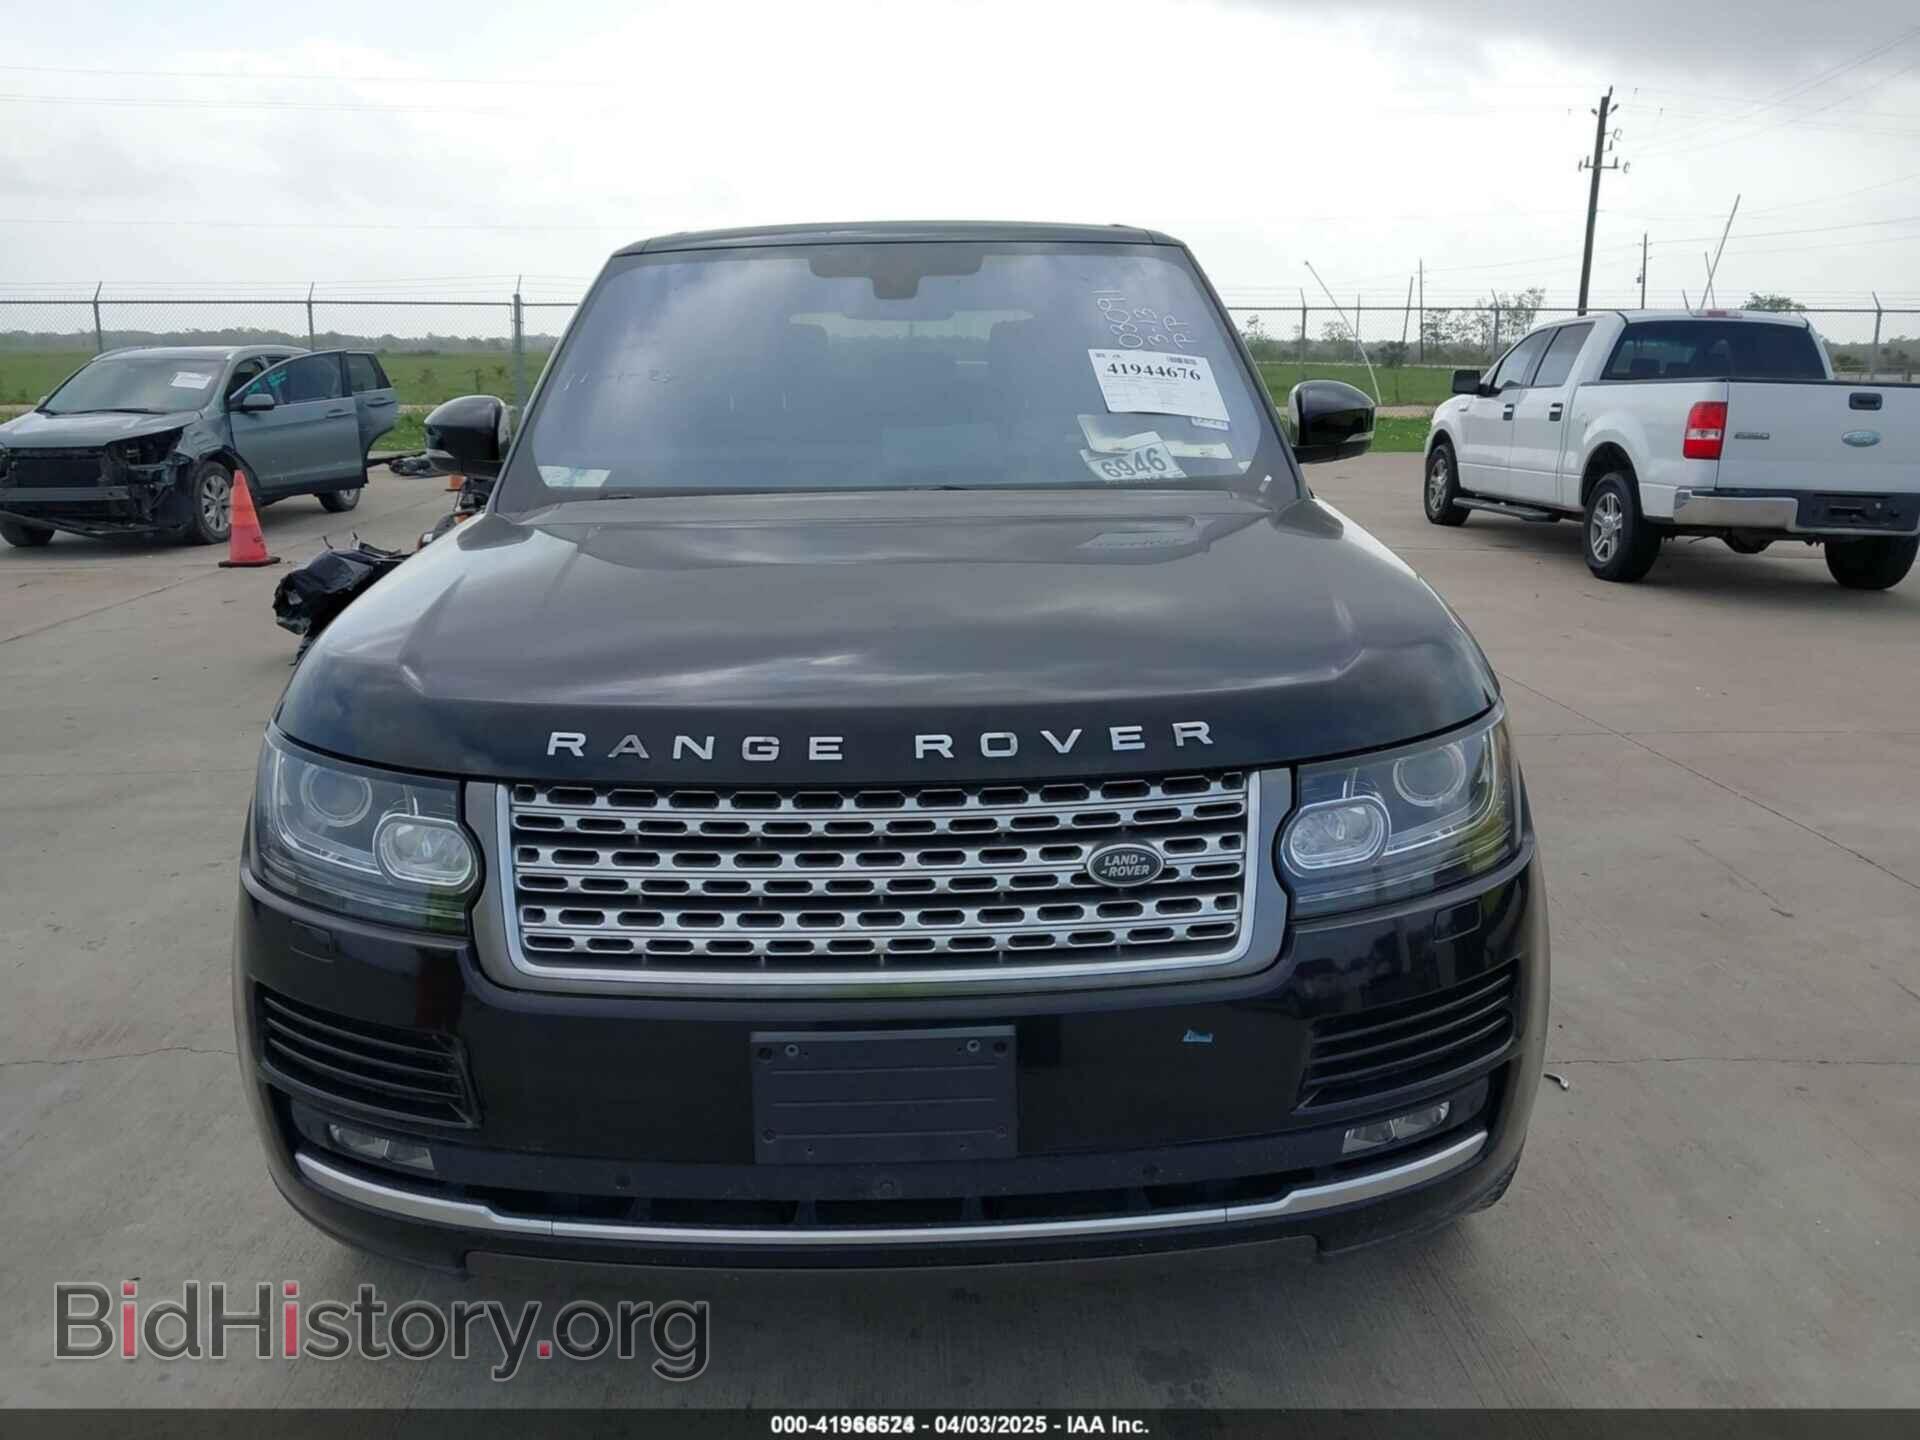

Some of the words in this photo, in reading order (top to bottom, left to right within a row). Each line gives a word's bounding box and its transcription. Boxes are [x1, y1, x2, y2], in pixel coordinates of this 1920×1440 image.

[1106, 362, 1201, 382] 41944676
[1100, 447, 1167, 478] 6946
[547, 732, 844, 761] RANGE
[915, 721, 1214, 759] ROVER
